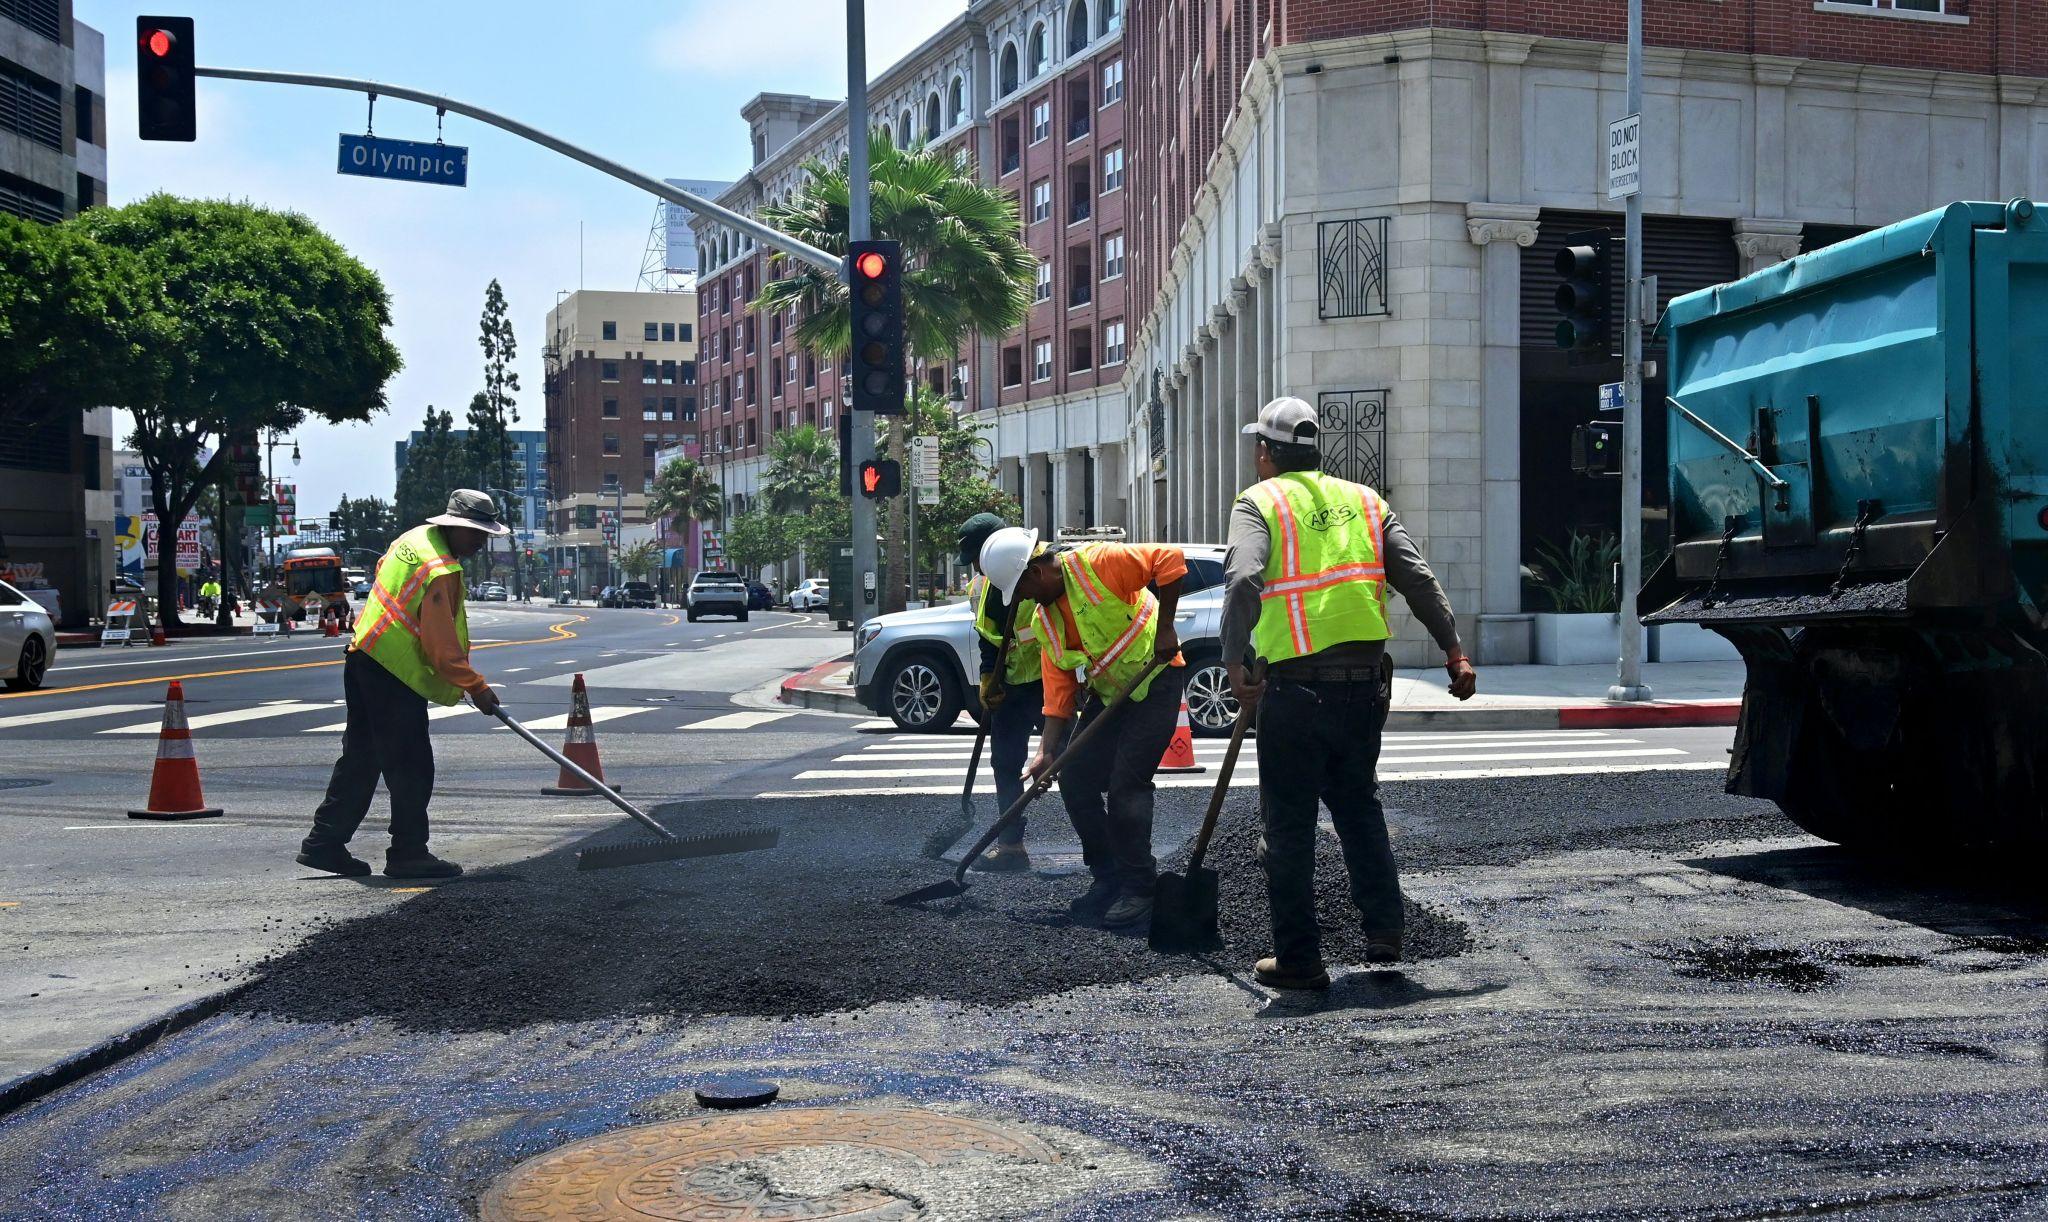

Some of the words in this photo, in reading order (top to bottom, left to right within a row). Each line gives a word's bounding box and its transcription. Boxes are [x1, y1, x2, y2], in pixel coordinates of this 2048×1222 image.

[1612, 129, 1621, 148] DO
[1624, 124, 1638, 145] NOT
[353, 145, 455, 176] Olympic
[1612, 148, 1637, 171] BLOCK
[1610, 172, 1638, 189] INTERSECTION
[1600, 386, 1613, 399] Main
[1311, 505, 1351, 526] APSS
[178, 530, 198, 541] ART
[177, 542, 199, 553] ENTER
